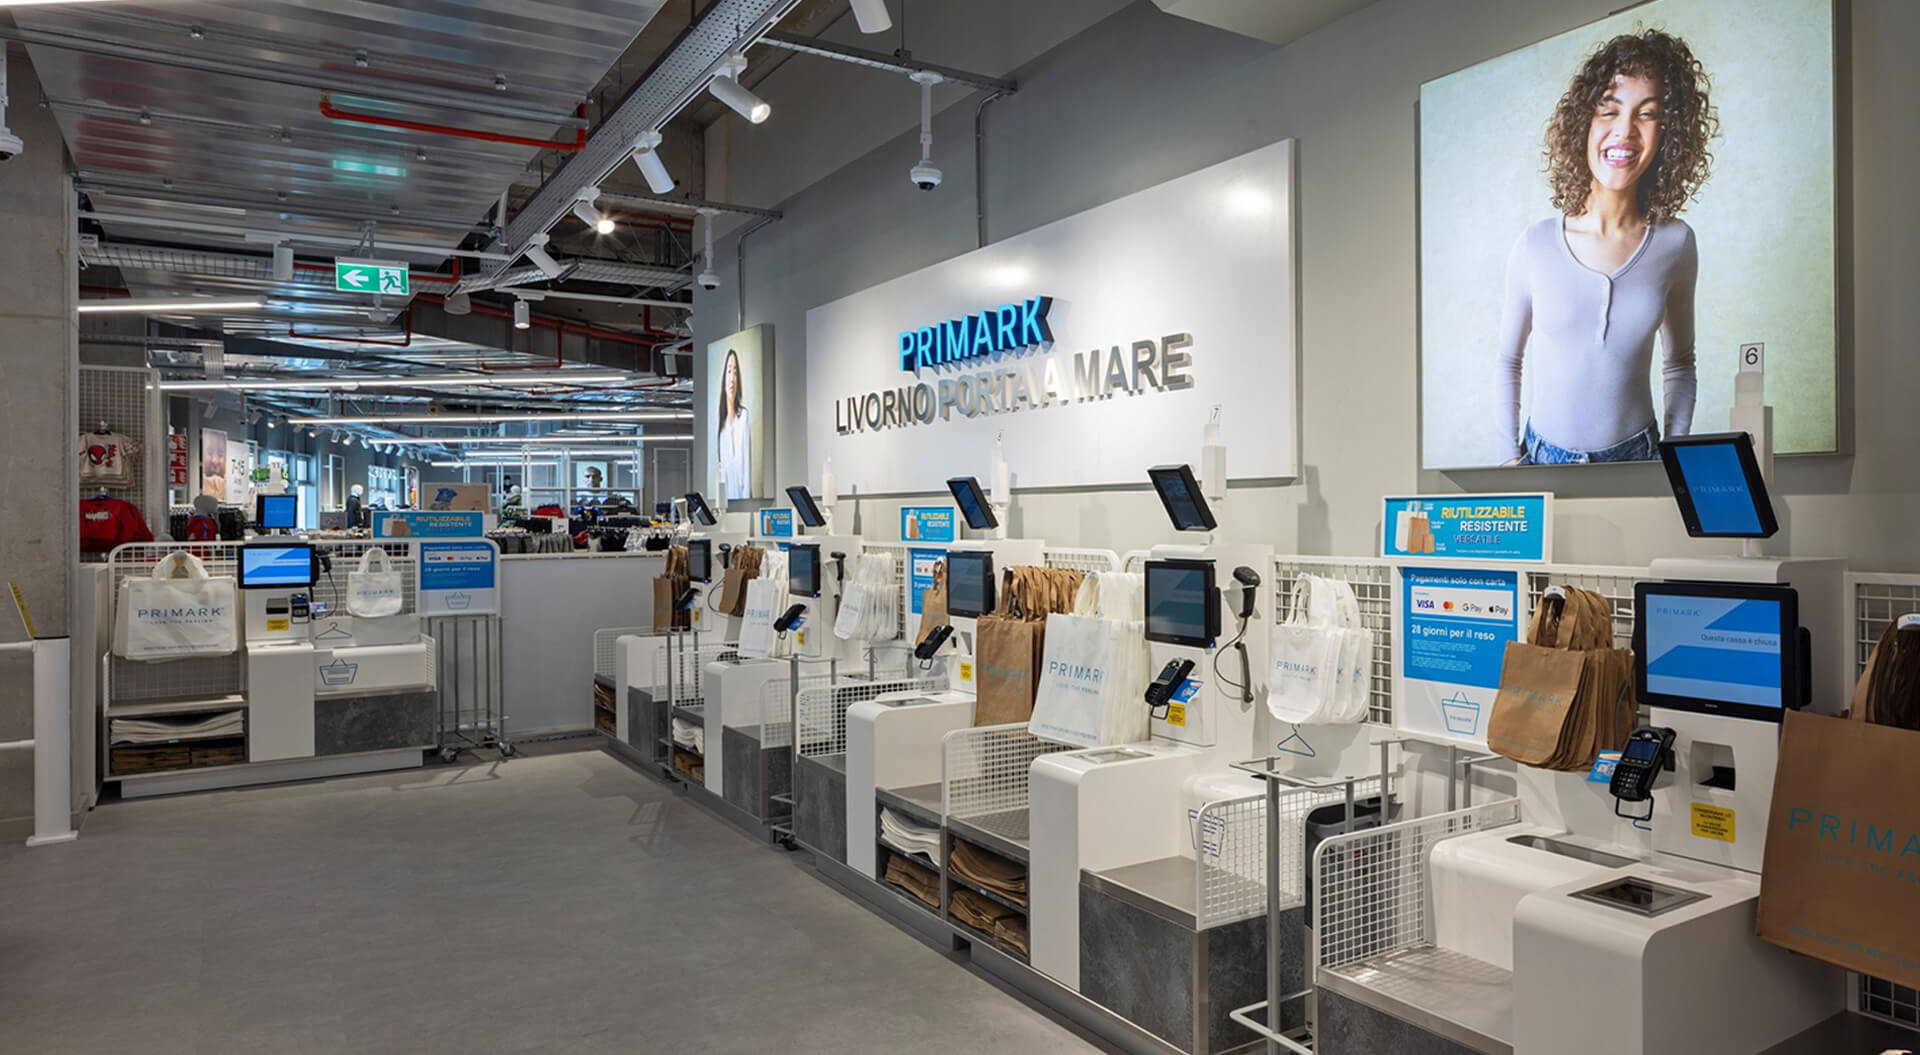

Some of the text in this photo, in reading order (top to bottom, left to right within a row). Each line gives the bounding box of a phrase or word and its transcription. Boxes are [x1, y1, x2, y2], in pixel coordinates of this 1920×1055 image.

[899, 296, 1048, 372] PRIMARK
[1745, 346, 1758, 365] 6
[836, 332, 1191, 434] LIVORNO PORTA A MARE
[1441, 506, 1525, 519] RIUTILIZZABILE
[1460, 520, 1528, 532] RESISTENTE
[1454, 534, 1501, 545] VERSATILE
[1410, 573, 1449, 585] Pagamenti
[1485, 578, 1506, 587] carta
[1416, 600, 1435, 609] VISA
[1495, 605, 1508, 615] Pay
[137, 607, 222, 618] PRIMARK
[1656, 607, 1701, 617] PRIMARK
[1411, 624, 1495, 641] 28 giorni per il reso
[1701, 633, 1725, 642] Questa
